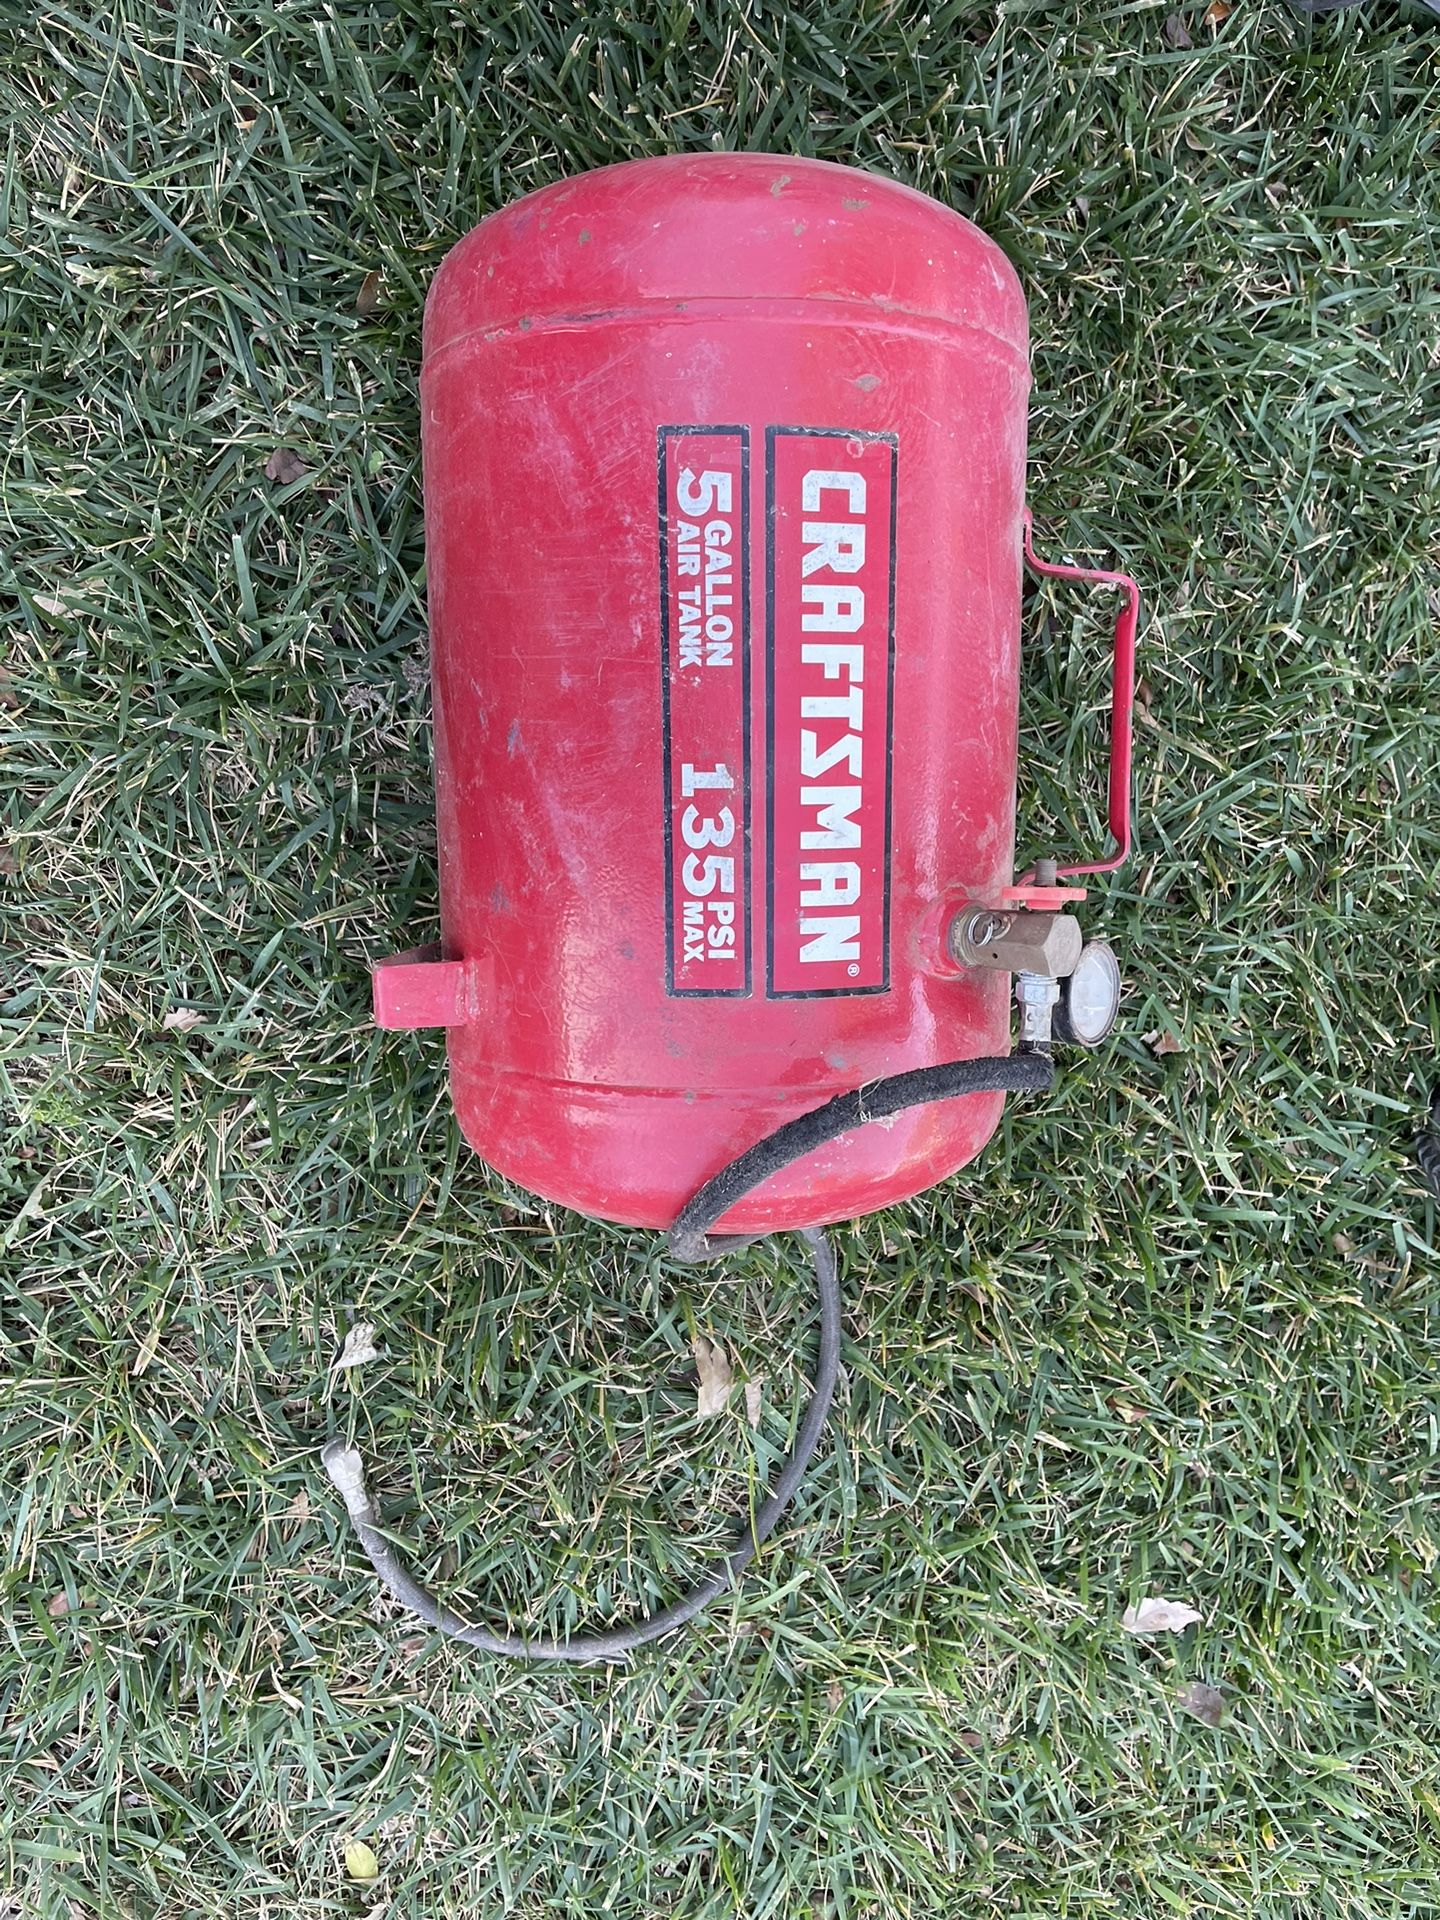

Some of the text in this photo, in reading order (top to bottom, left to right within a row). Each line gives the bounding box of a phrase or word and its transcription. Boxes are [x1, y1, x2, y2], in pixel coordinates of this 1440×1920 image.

[677, 468, 733, 516] 5
[677, 519, 702, 668] AIR TANK
[704, 519, 734, 667] GALLON
[681, 762, 735, 897] 135
[683, 900, 706, 962] MAX
[707, 900, 735, 960] PSI
